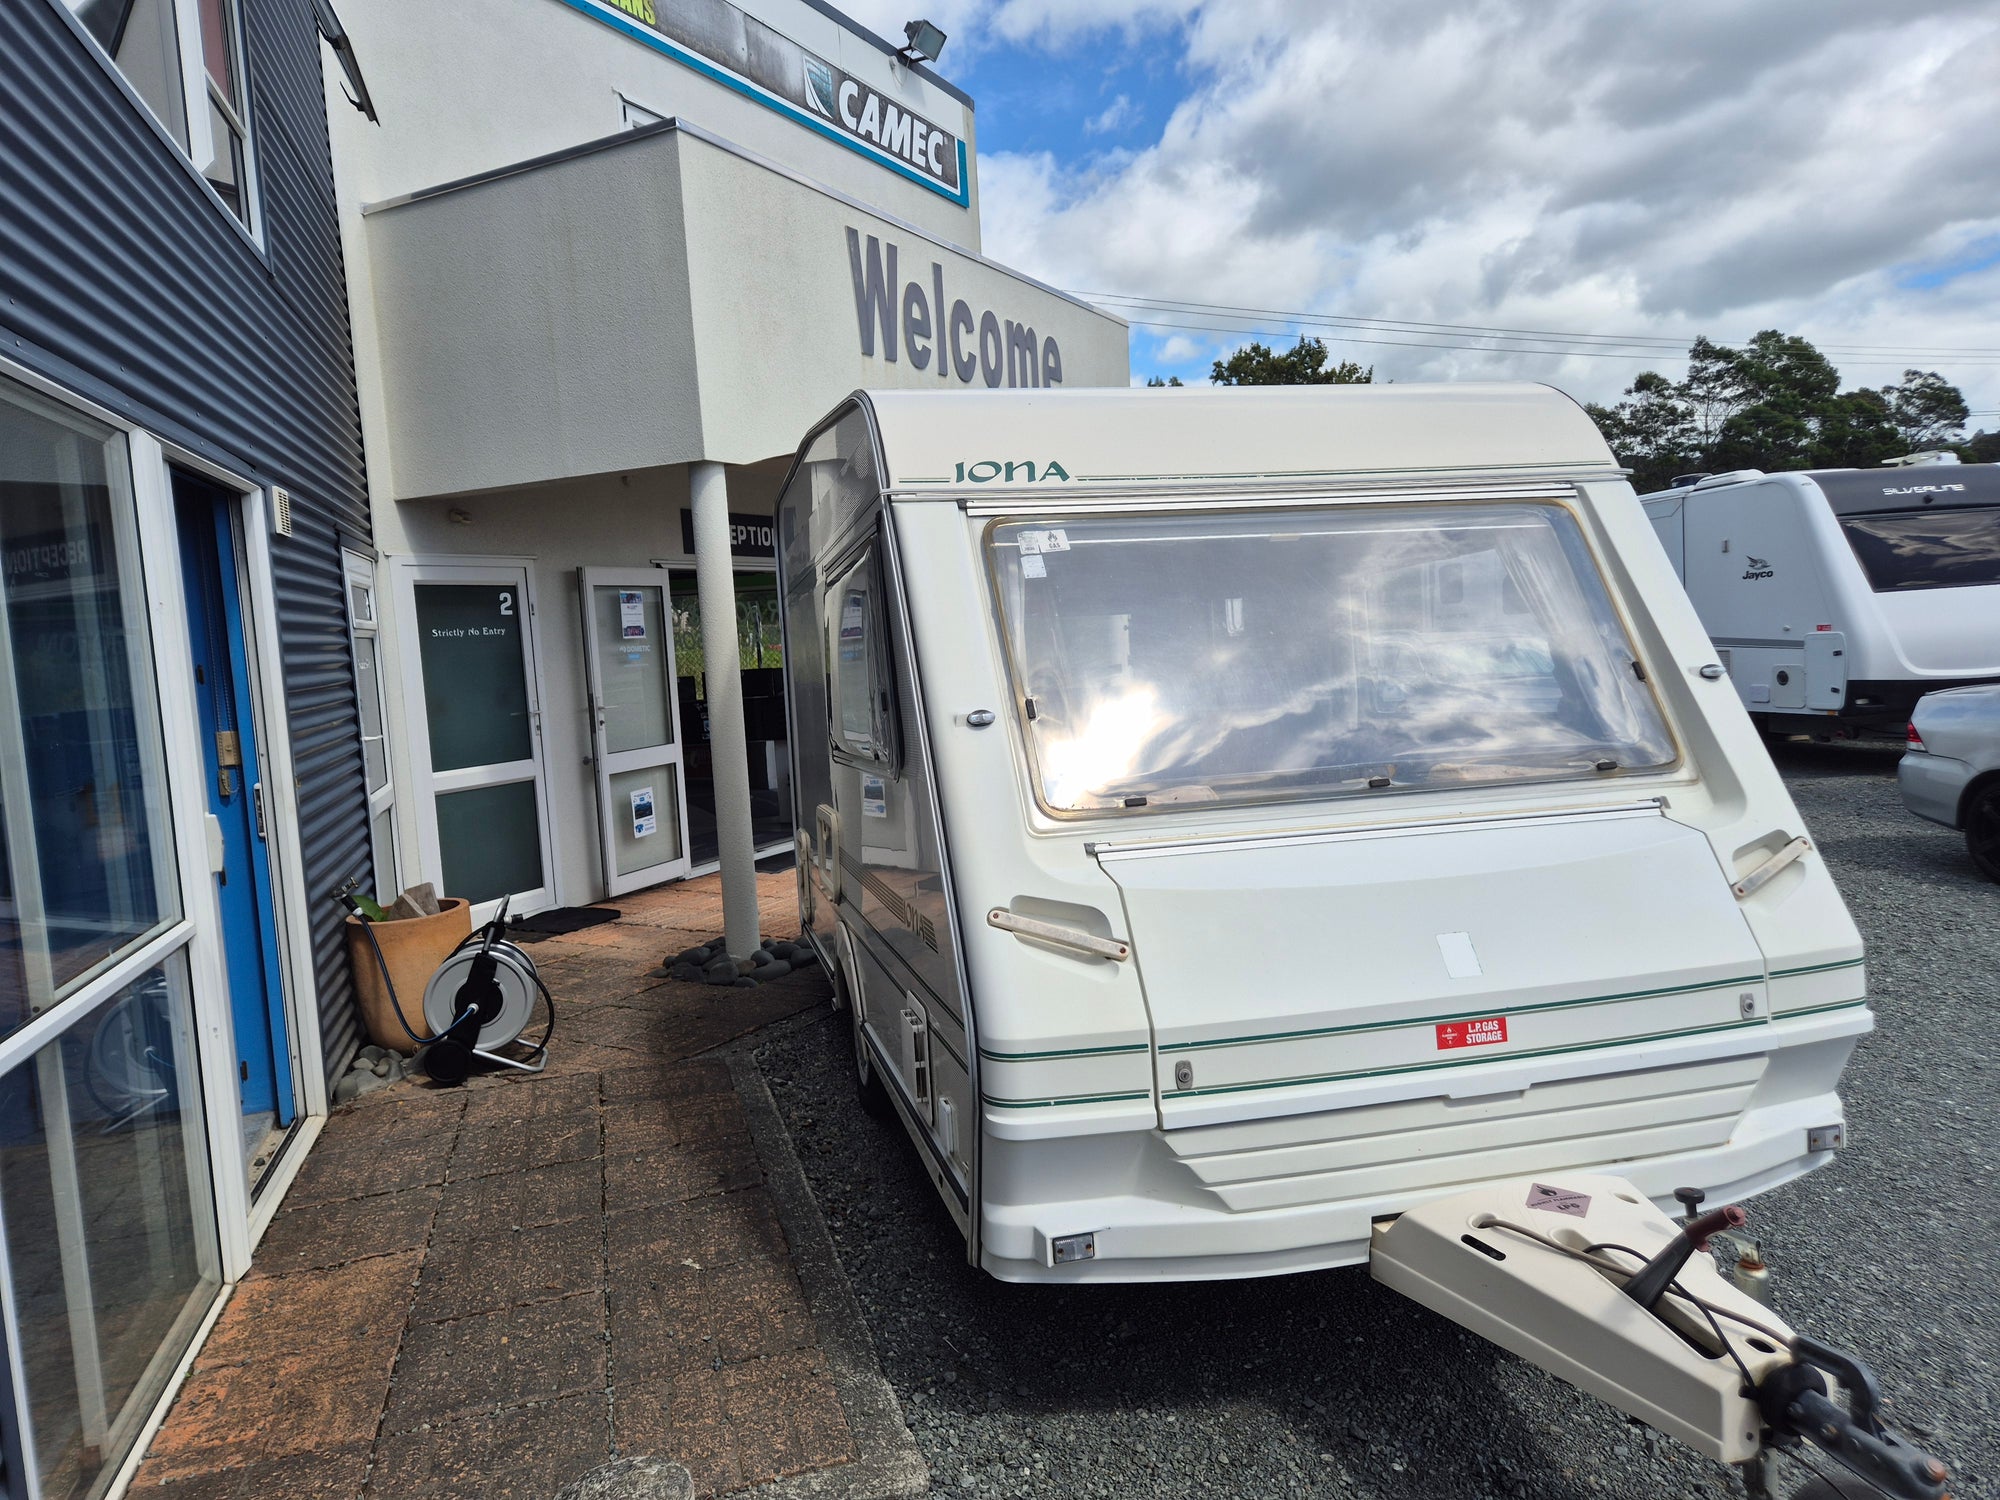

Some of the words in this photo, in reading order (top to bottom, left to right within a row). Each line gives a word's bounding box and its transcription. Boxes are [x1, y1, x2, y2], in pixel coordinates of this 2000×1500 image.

[838, 79, 944, 177] CAMEC
[845, 225, 1063, 388] Welcome
[1882, 484, 1966, 496] SILVERLINE
[730, 524, 775, 547] EPTIO
[1742, 570, 1774, 580] Jayco
[499, 592, 513, 616] 2
[431, 628, 465, 638] Strictly
[468, 627, 480, 636] No
[482, 626, 506, 636] Entry
[1482, 1020, 1499, 1031] GAS
[1466, 1030, 1503, 1044] STORAGE
